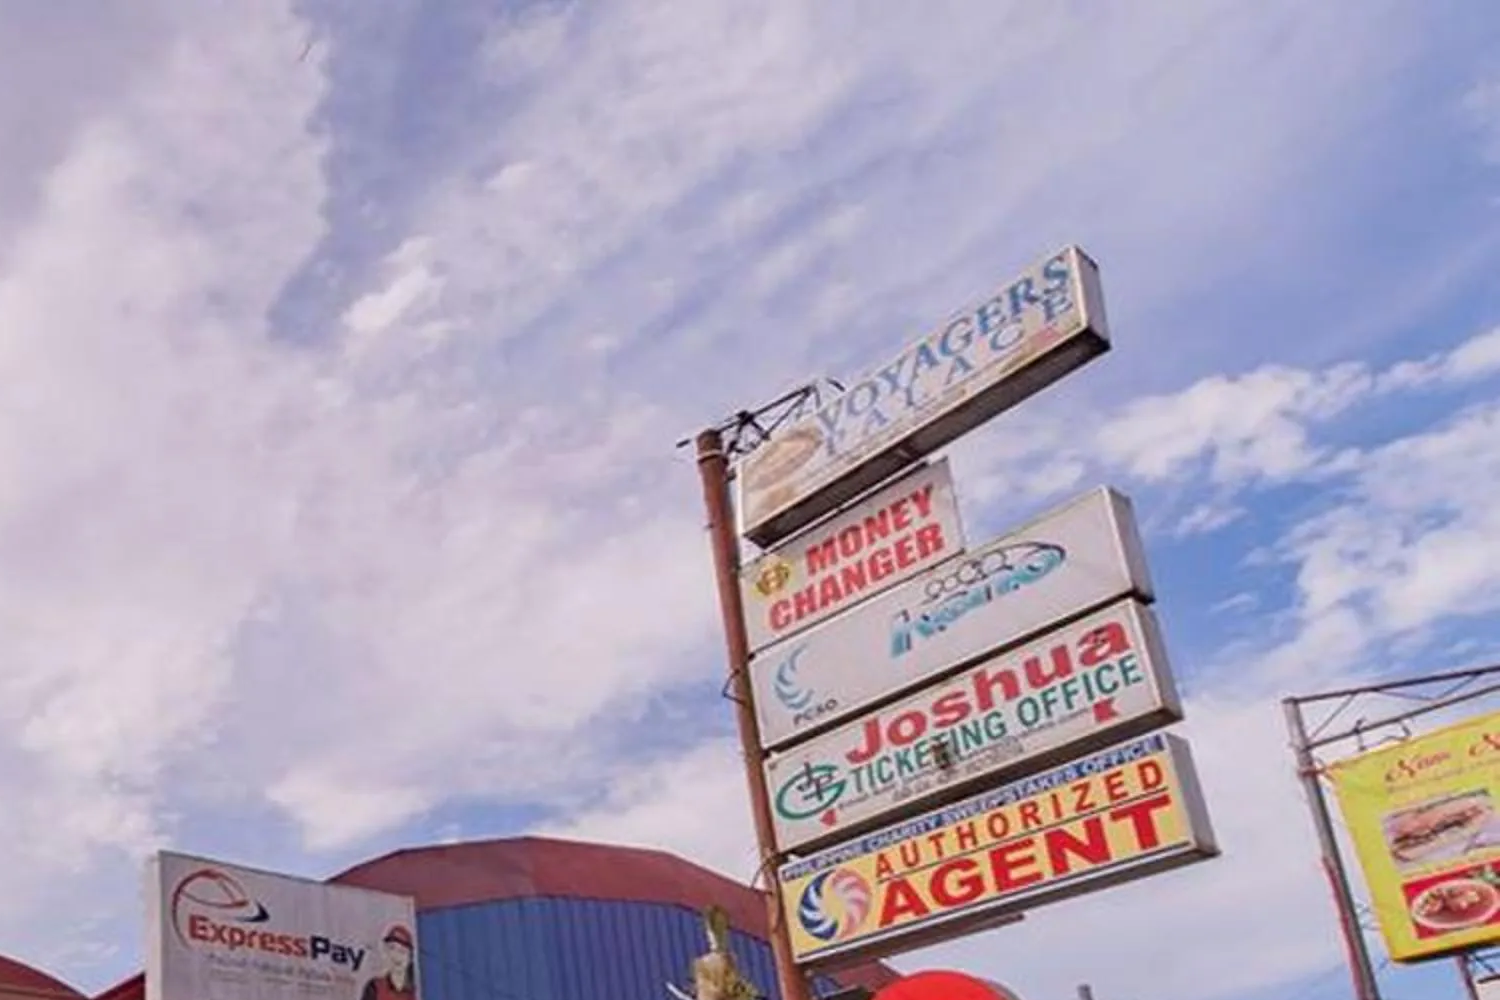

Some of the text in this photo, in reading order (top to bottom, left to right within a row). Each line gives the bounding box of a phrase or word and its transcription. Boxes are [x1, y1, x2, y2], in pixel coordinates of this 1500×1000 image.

[814, 255, 1070, 432] VOYAGERS
[768, 522, 947, 631] CHANGER
[804, 484, 934, 578] MONEY
[844, 620, 1132, 766] Joshua
[850, 708, 1007, 793] TICKETING
[1016, 653, 1144, 729] OFFICE
[874, 758, 1167, 879] AUTHORIZED
[877, 793, 1173, 928] AGENT
[188, 913, 366, 971] ExpressPay
